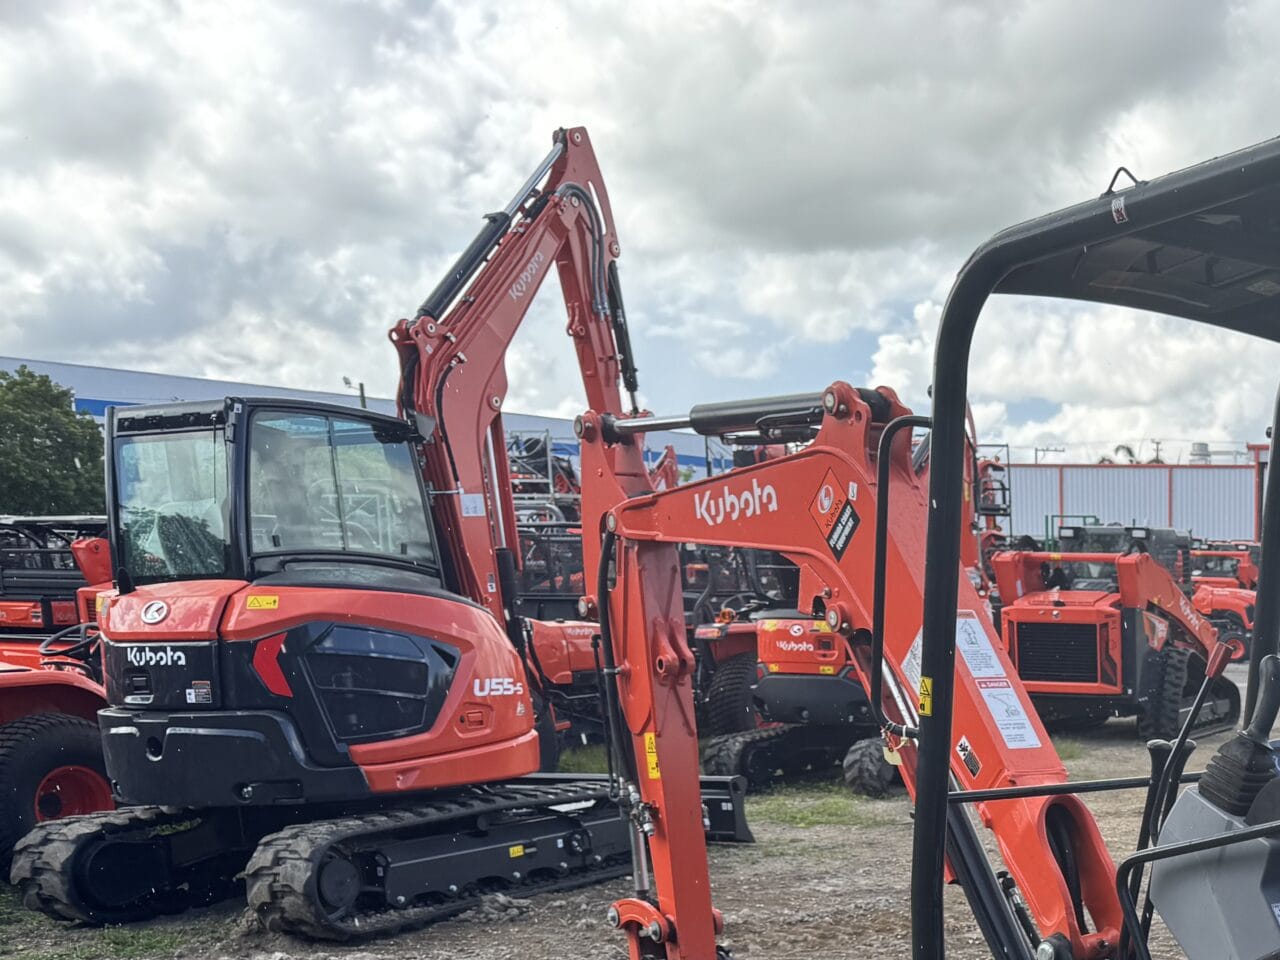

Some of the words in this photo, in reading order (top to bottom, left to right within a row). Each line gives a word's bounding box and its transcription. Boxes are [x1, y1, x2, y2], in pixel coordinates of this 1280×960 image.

[694, 478, 778, 526] Kubota
[127, 646, 186, 666] Kubota
[776, 641, 814, 652] Kubota
